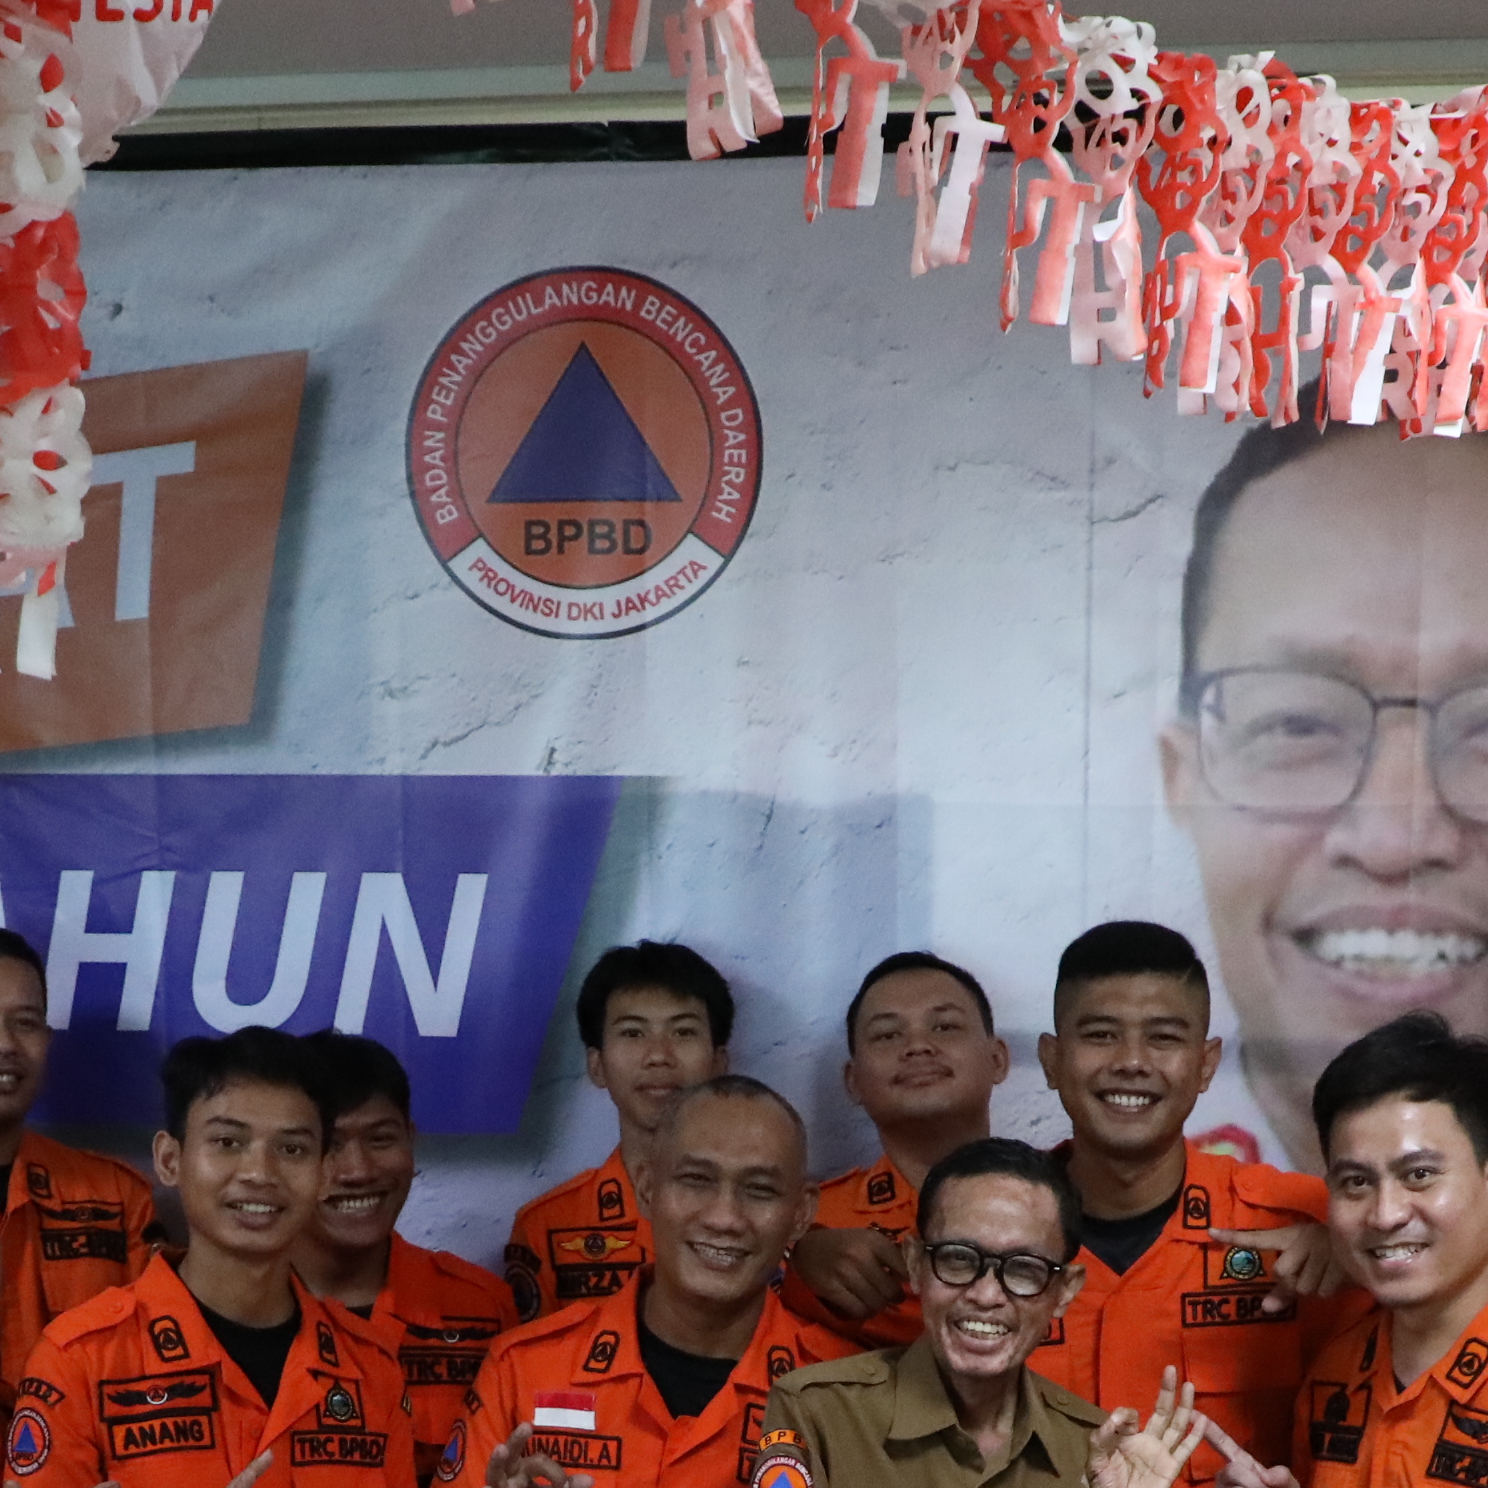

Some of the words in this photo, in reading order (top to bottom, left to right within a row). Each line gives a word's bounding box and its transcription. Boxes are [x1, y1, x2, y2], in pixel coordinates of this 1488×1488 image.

[426, 280, 636, 423] PENANGGULANGAN
[640, 294, 736, 406] BENCANA
[424, 431, 458, 525] BADAN
[711, 407, 748, 524] DAERAH
[524, 519, 652, 556] BPBD
[468, 556, 562, 619] PROVINSI
[567, 601, 605, 622] DKI
[610, 559, 709, 620] JAKARTA
[1189, 1299, 1231, 1320] TRC
[405, 1357, 444, 1380] TRC
[123, 1420, 204, 1450] ANANG
[297, 1436, 336, 1459] TRC
[338, 1437, 383, 1461] BPBD
